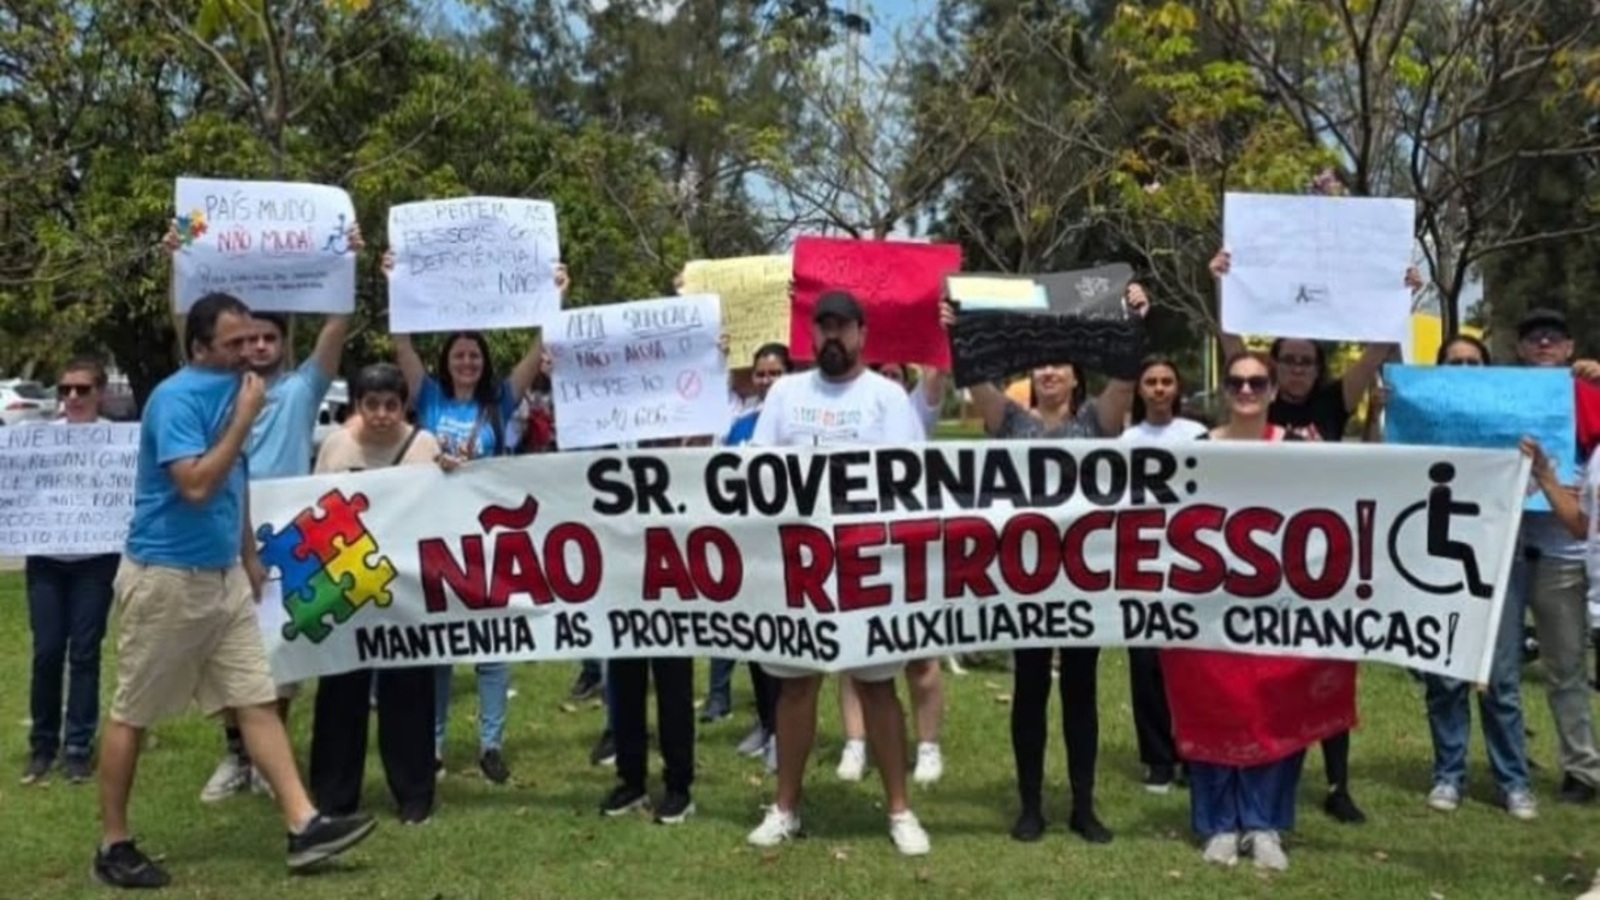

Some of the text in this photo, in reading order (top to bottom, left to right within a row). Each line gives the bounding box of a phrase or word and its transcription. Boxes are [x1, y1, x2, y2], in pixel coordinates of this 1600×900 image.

[205, 190, 252, 222] PAÍS
[217, 224, 252, 254] NÃO
[587, 447, 1197, 516] SR. GOVERNADOR:
[418, 494, 1376, 614] NÃO AO RETROCESSO!
[356, 598, 1459, 666] MANTENHA AS PROFESSORAS AUXILIARES DAS CRIANÇAS!
